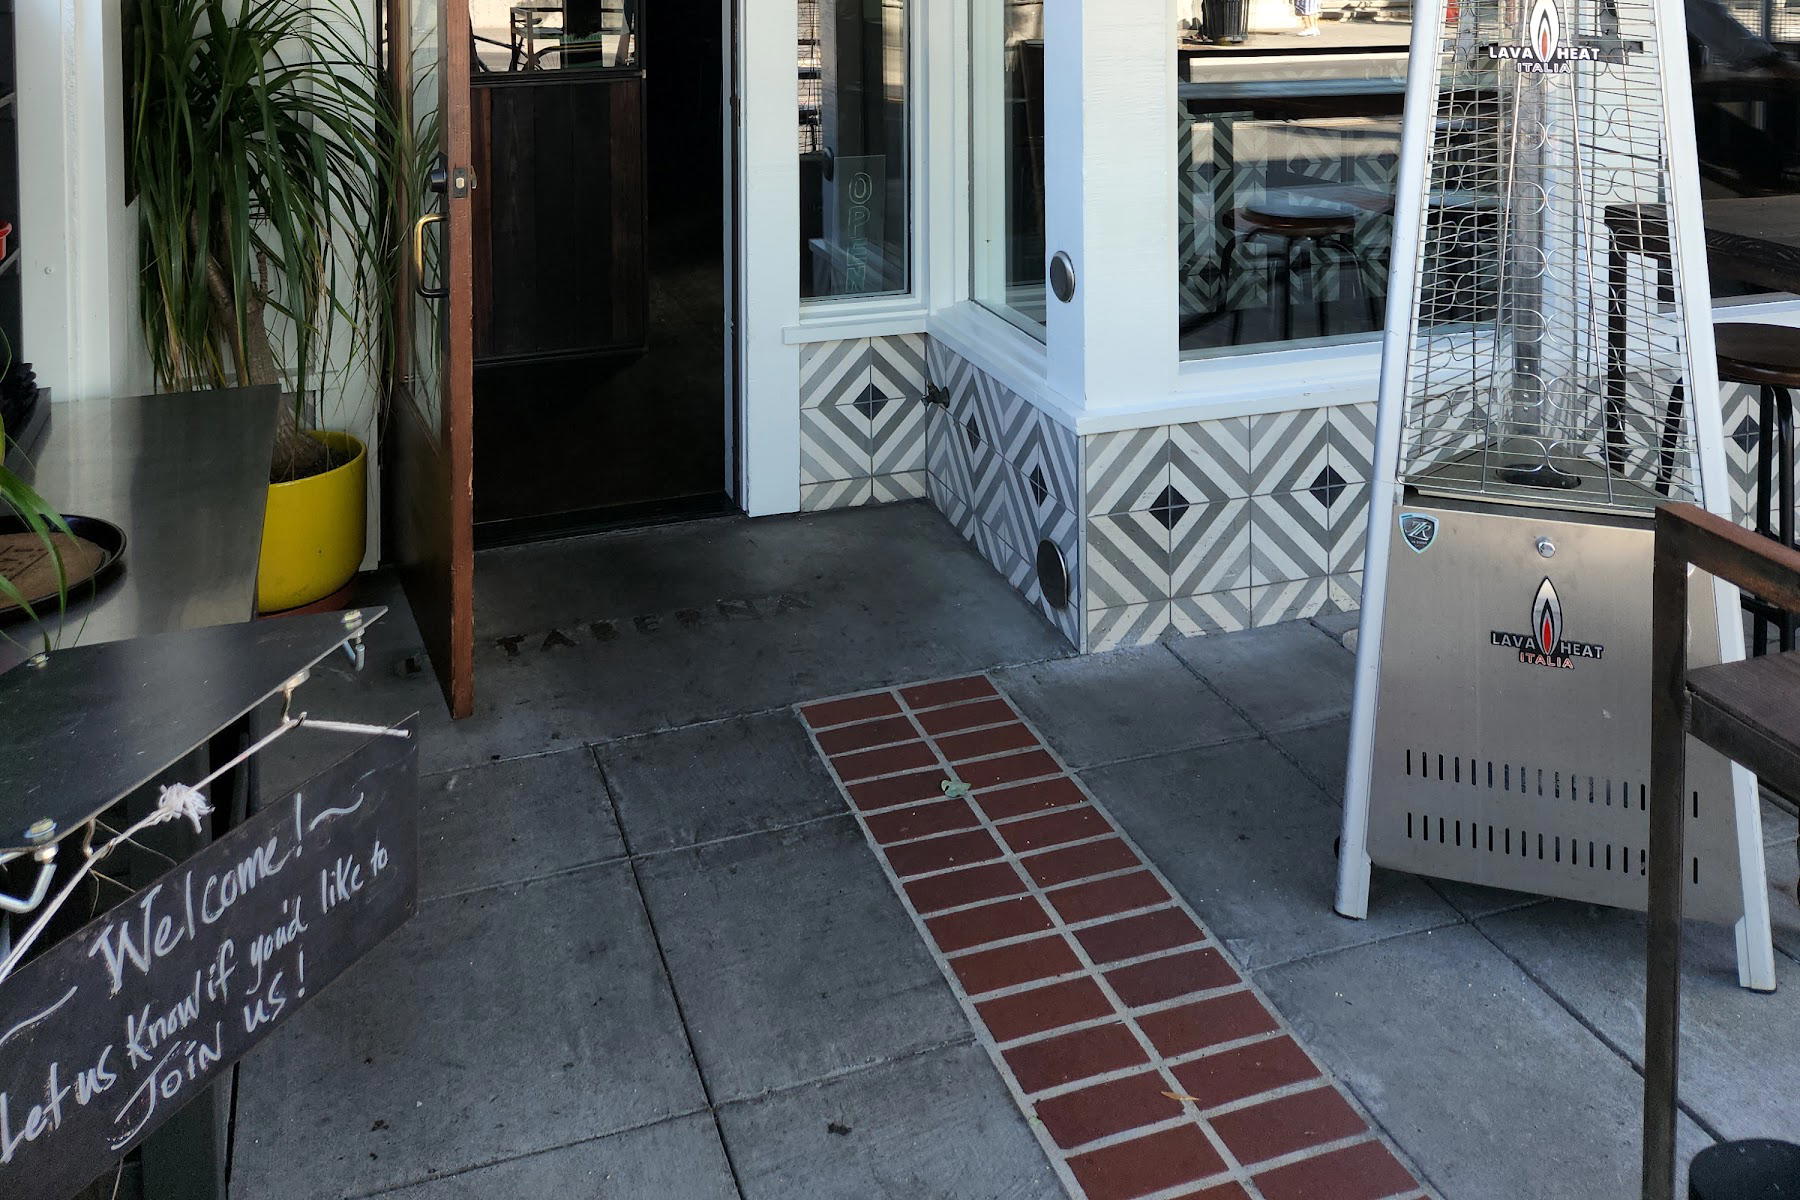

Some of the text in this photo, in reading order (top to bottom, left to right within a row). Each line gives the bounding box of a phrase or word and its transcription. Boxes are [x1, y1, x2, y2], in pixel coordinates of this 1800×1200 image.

[1489, 46, 1601, 61] LAVA HEAT
[1516, 62, 1572, 74] ITALIA
[845, 171, 873, 293] OPEN
[1491, 631, 1604, 659] LAVA HEAT
[1518, 652, 1575, 670] ITALIA
[370, 840, 389, 877] to
[89, 793, 305, 999] Welcome!
